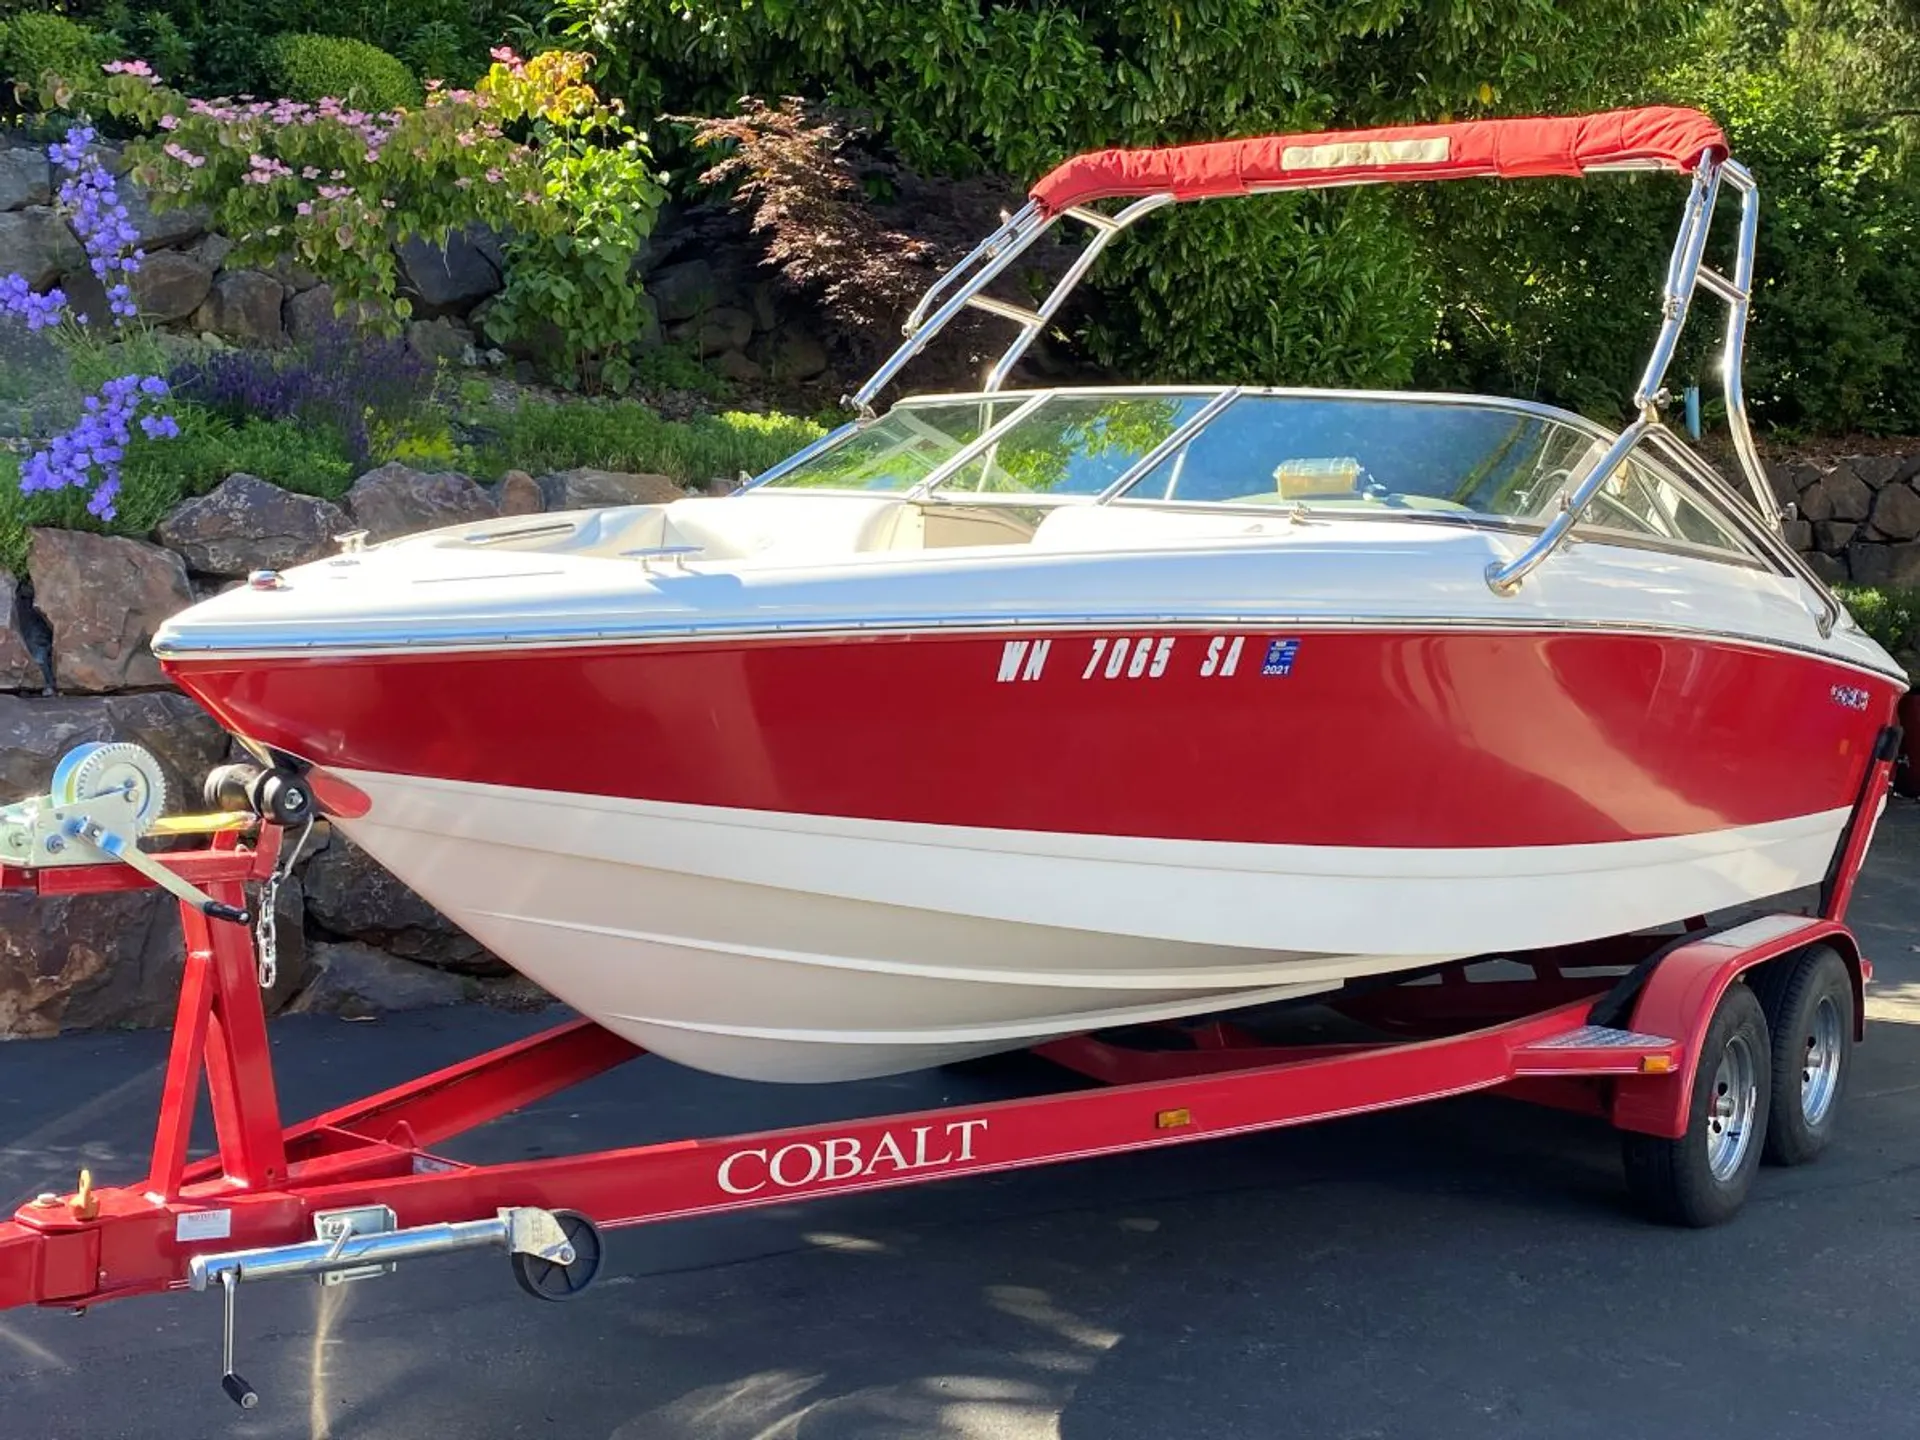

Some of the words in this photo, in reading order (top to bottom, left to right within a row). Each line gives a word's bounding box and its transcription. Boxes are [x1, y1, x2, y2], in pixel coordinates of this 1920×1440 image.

[997, 640, 1052, 682] WN
[1082, 637, 1175, 679] 7065
[1200, 636, 1245, 677] SA
[1262, 665, 1290, 675] 2021
[717, 1119, 988, 1194] COBALT
